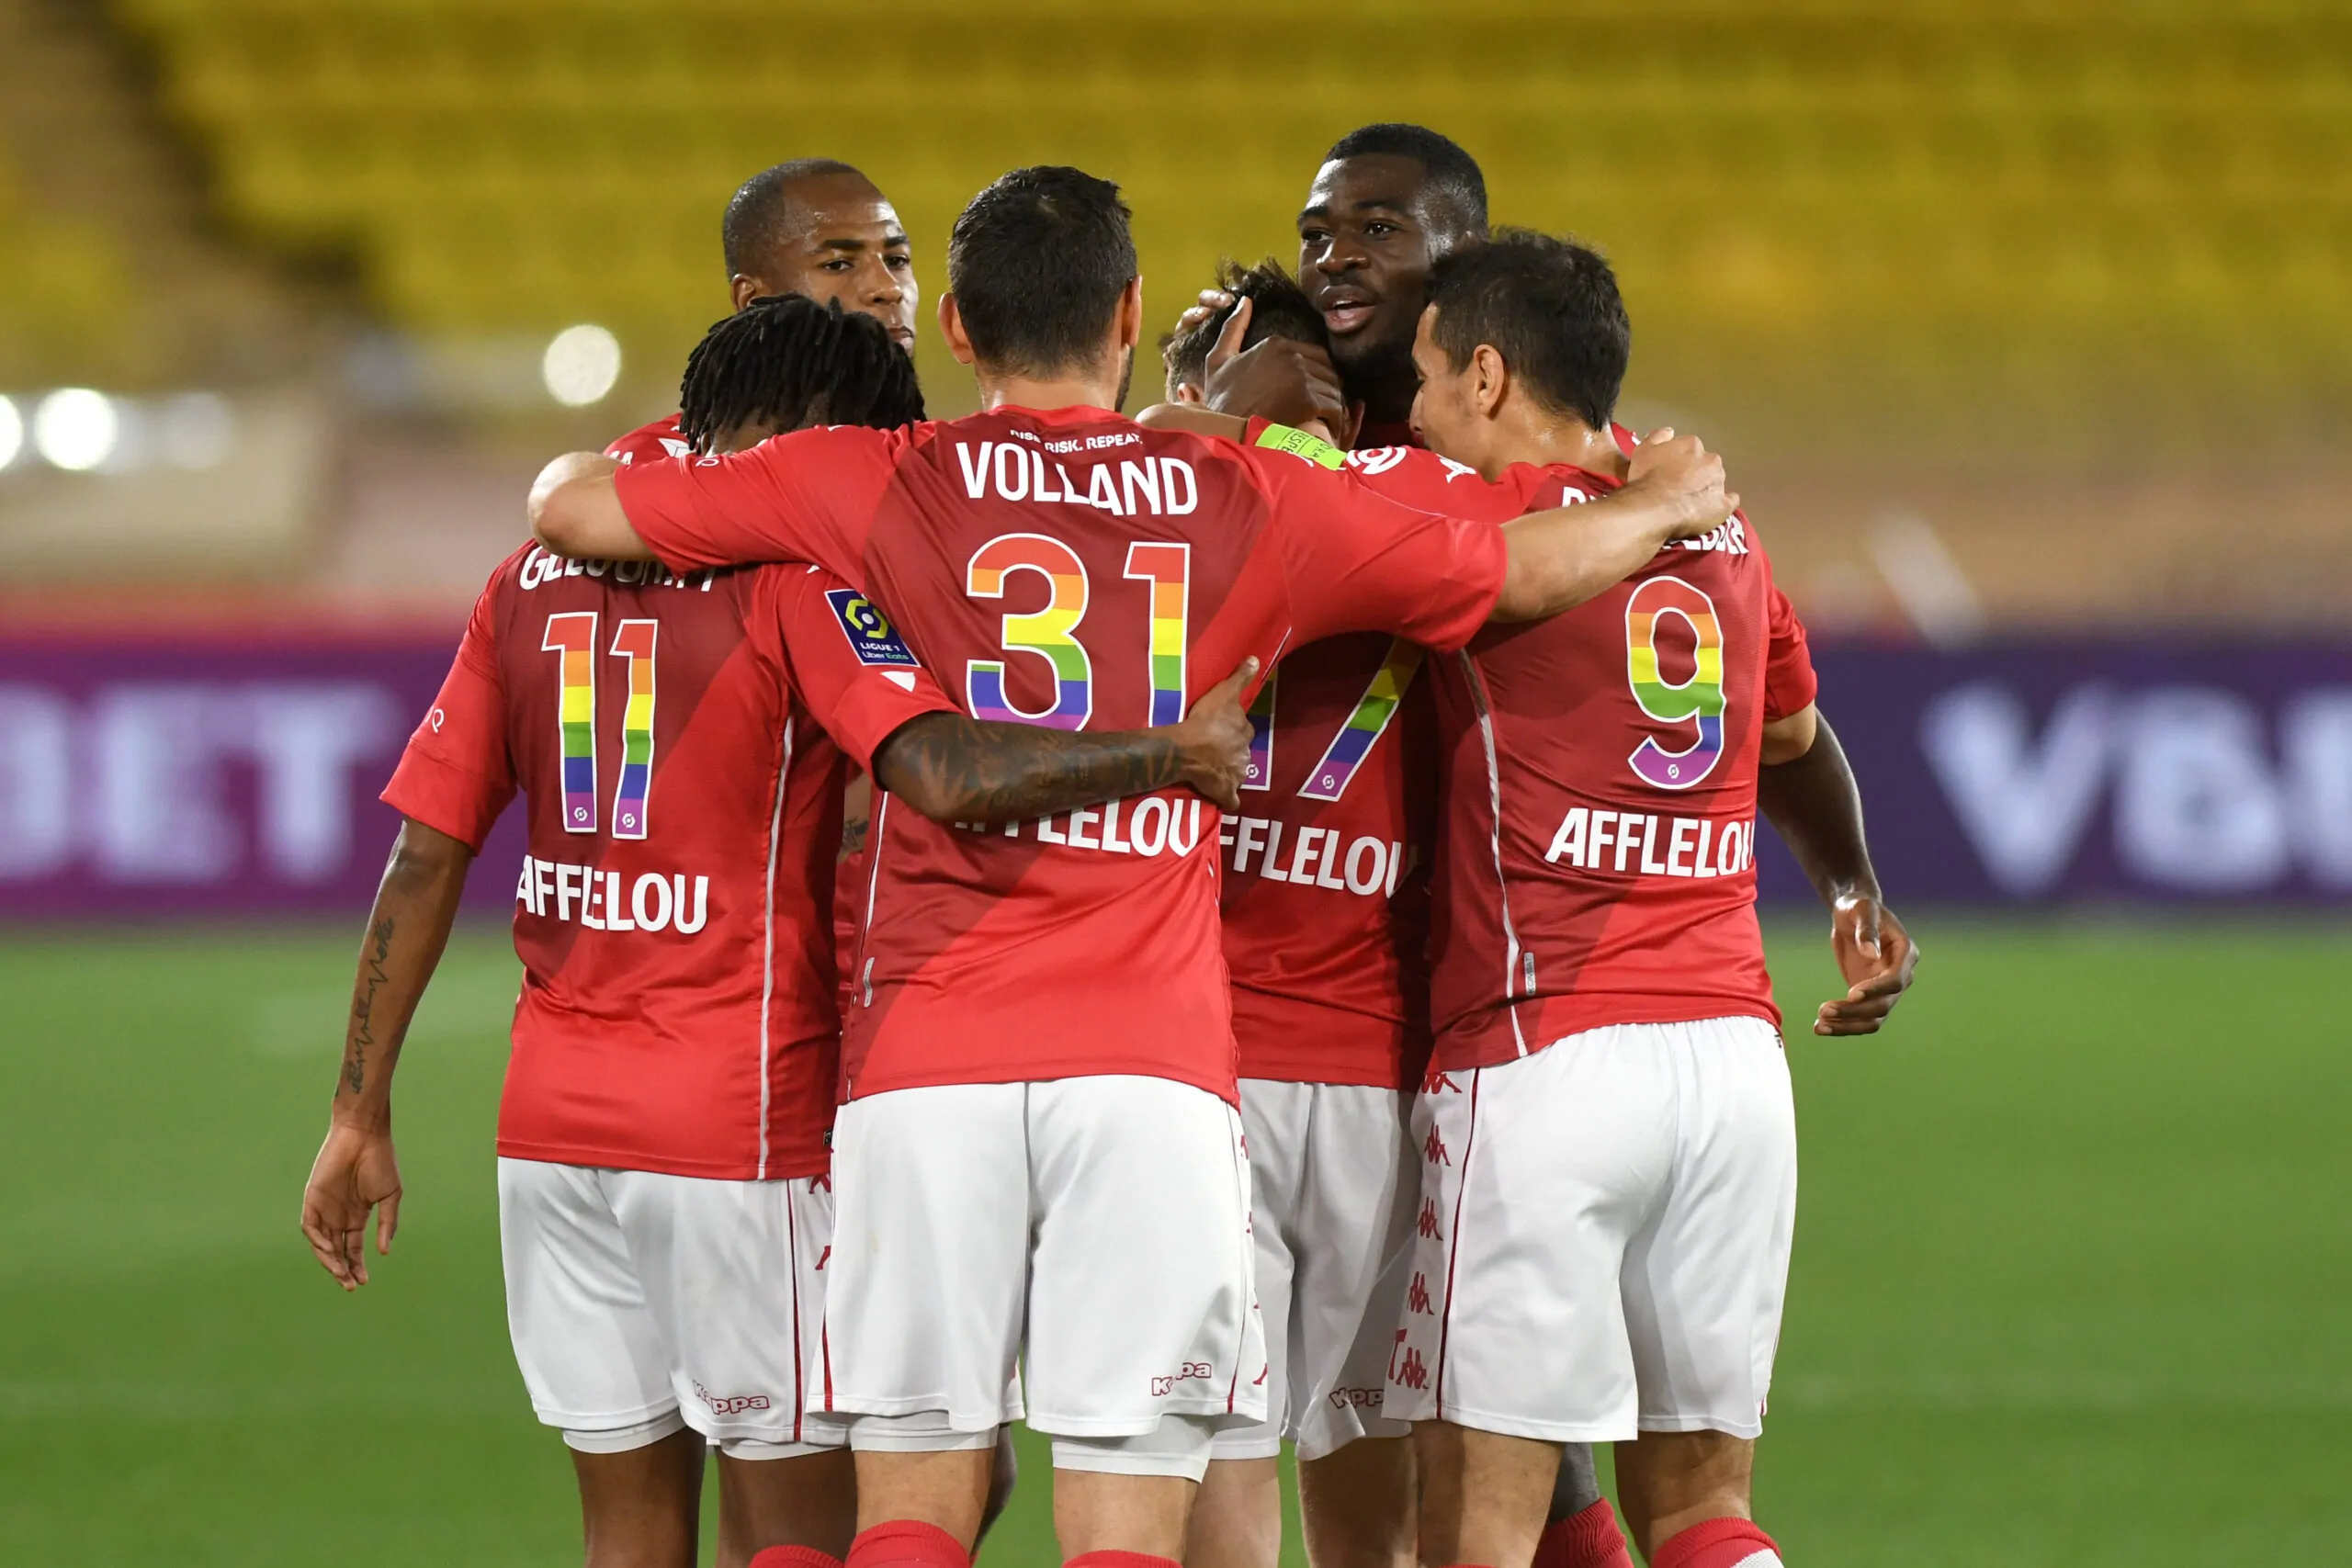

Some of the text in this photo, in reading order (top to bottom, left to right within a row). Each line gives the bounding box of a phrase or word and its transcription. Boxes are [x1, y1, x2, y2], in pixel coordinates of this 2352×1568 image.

[956, 441, 1198, 516] VOLLAND
[1044, 439, 1083, 454] RISK.
[860, 642, 893, 651] LIGUE
[967, 533, 1191, 731] 31
[1625, 576, 1727, 789] 9
[541, 612, 658, 840] 11
[955, 796, 1201, 857] LELOU
